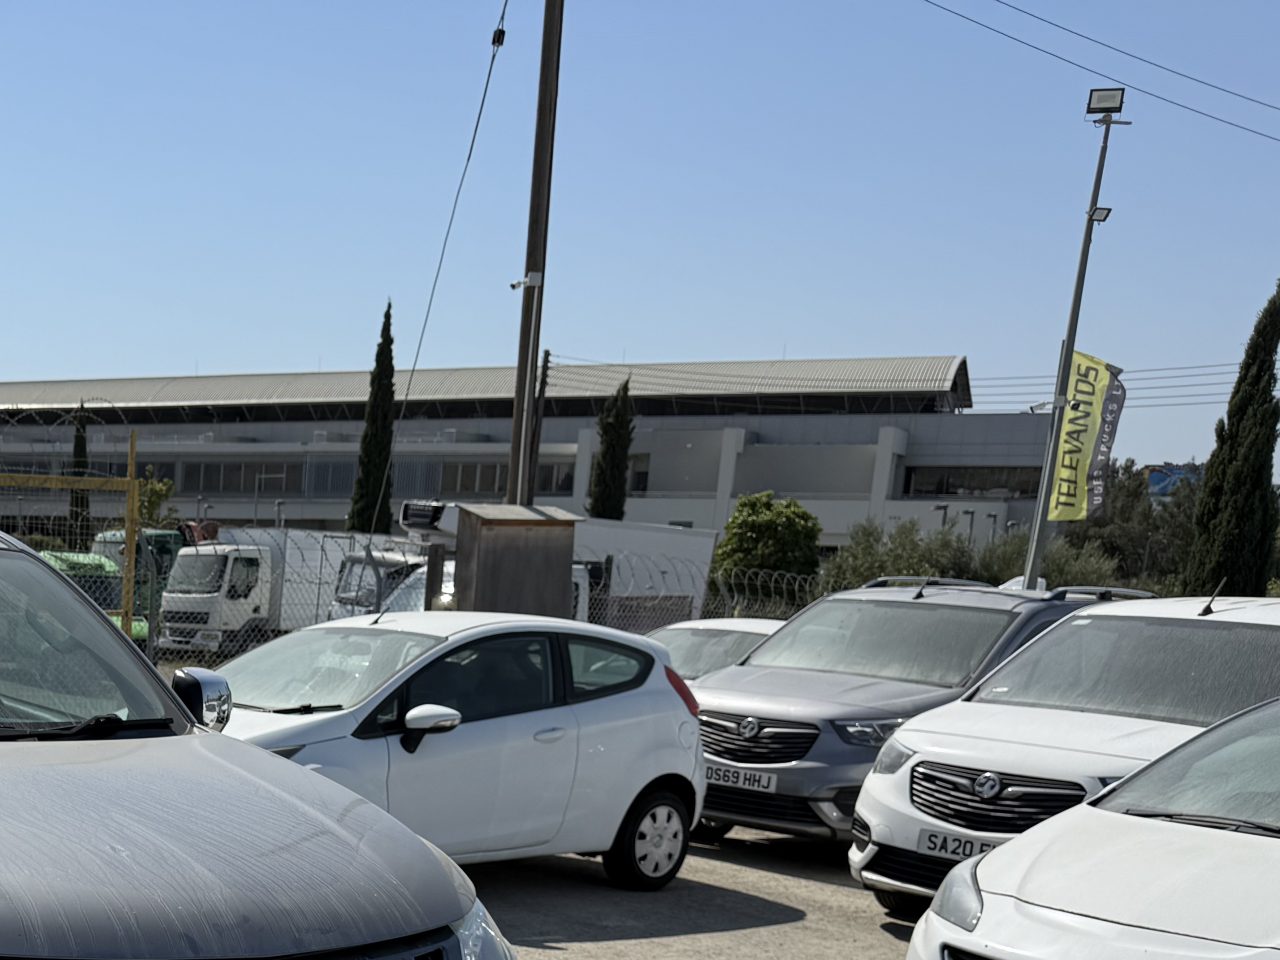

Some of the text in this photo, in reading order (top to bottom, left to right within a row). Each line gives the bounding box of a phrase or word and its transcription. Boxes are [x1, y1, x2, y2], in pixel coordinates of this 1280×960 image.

[705, 766, 771, 789] DS69 HHJ
[927, 833, 974, 857] SA20
